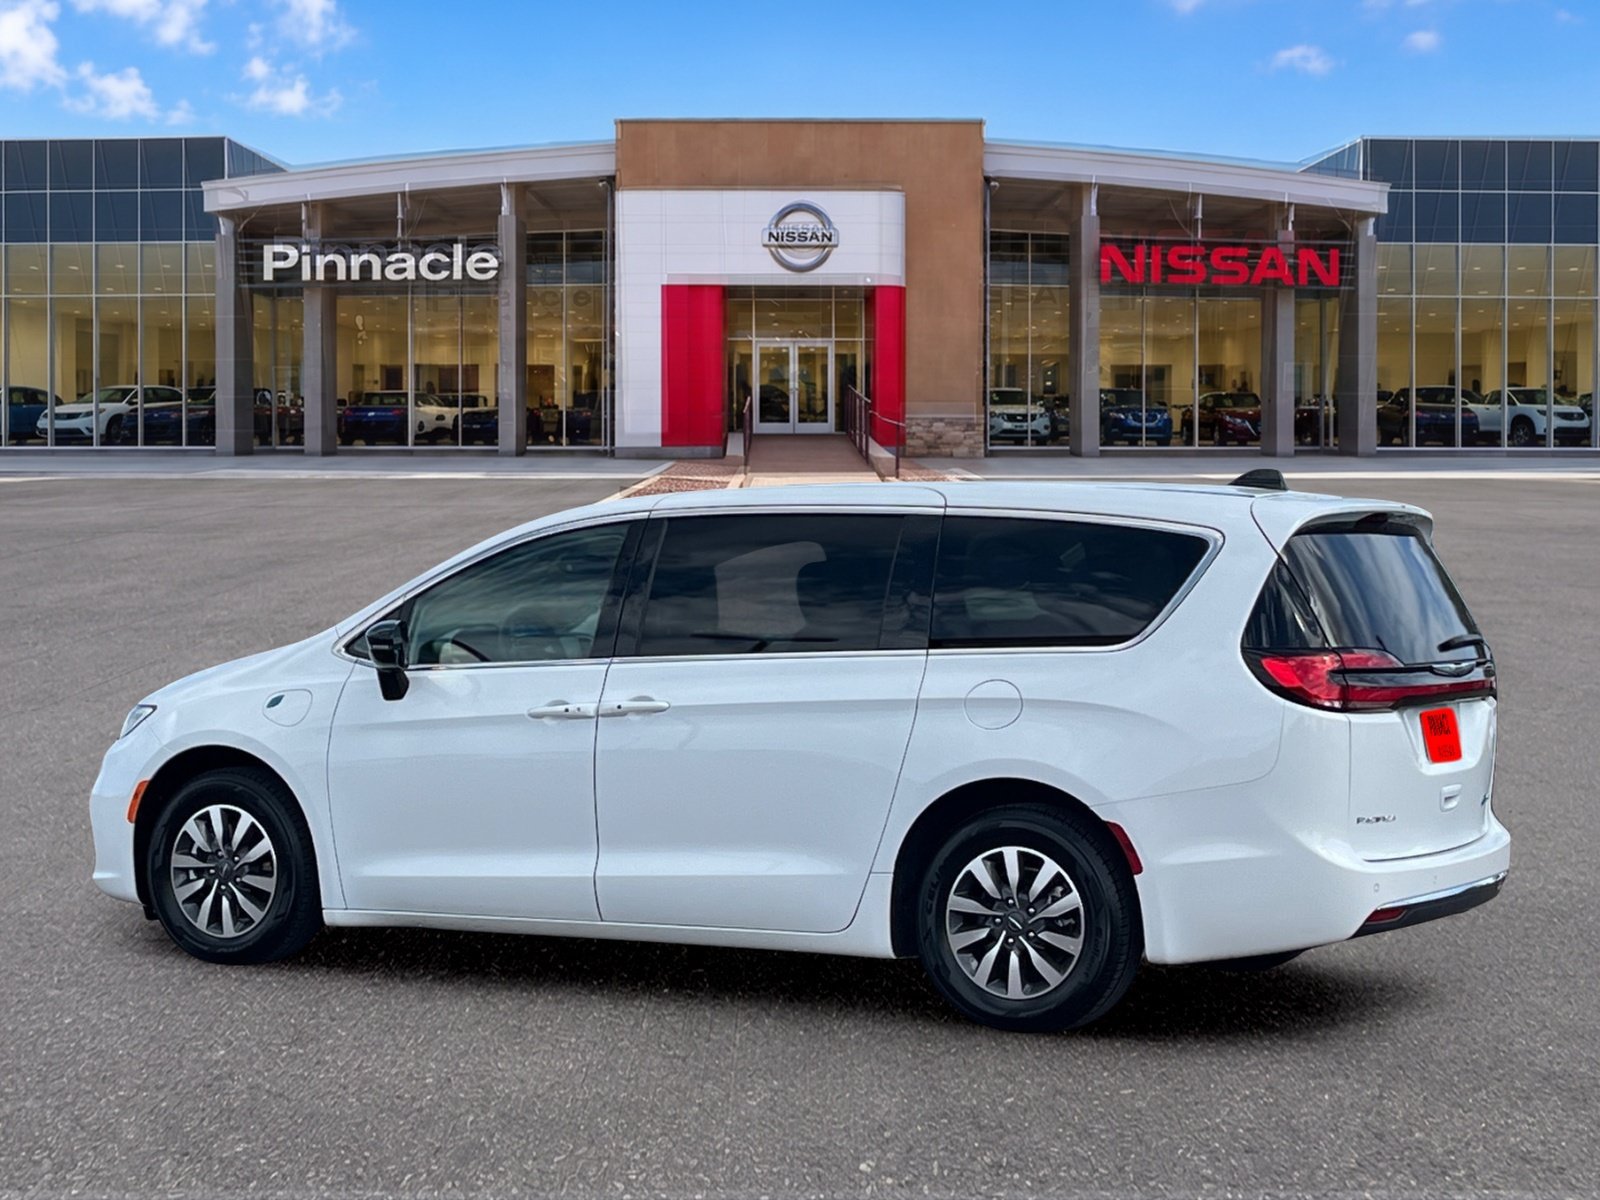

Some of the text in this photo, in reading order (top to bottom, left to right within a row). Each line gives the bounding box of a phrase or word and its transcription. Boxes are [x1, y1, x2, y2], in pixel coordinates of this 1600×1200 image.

[768, 231, 833, 242] NISSAN
[263, 243, 499, 281] Pinnacle
[1099, 245, 1341, 286] NISSAN
